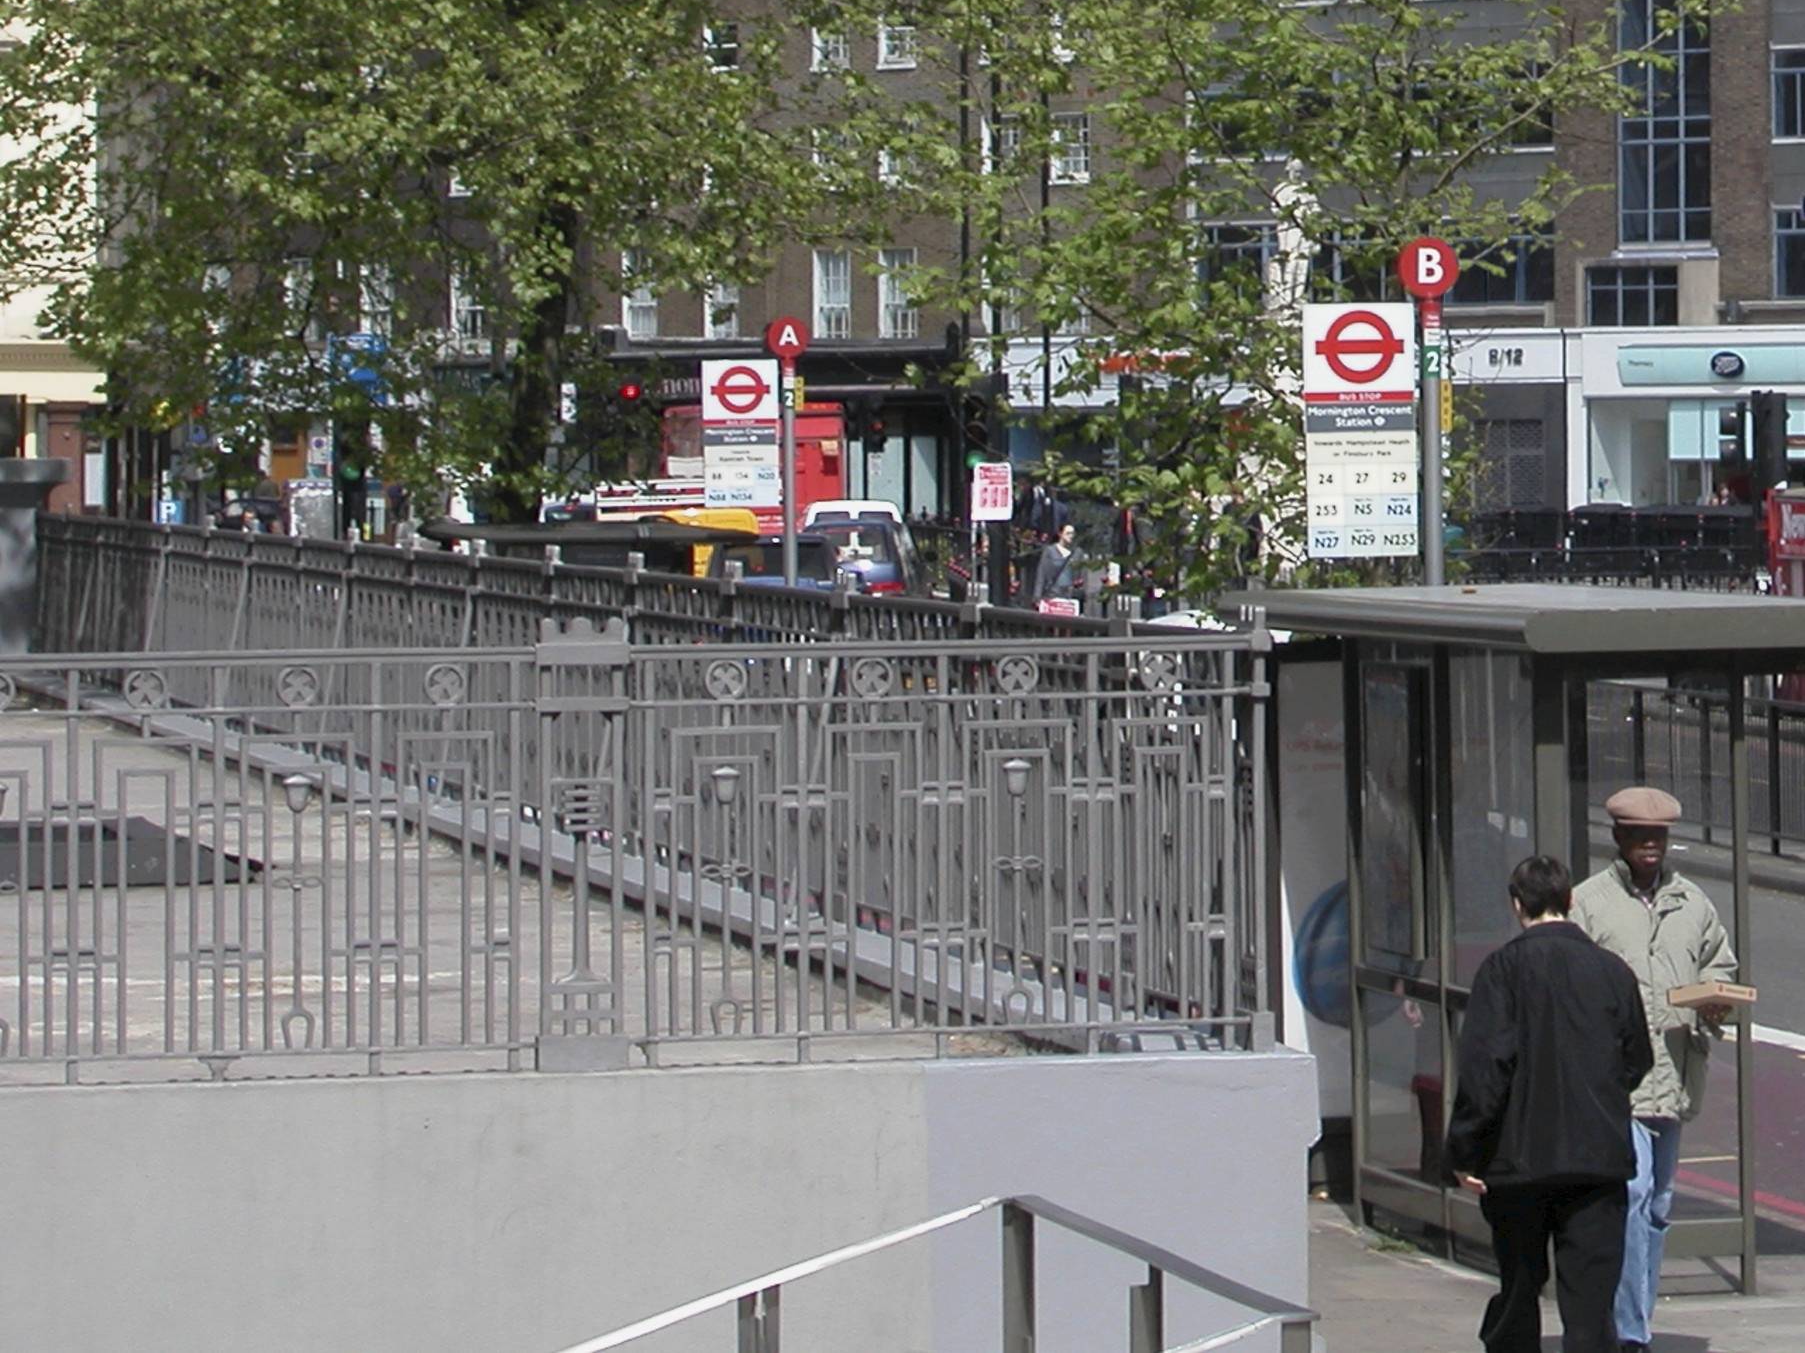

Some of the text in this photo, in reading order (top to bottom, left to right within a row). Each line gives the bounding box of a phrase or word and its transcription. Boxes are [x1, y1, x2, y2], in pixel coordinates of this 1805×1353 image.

[1418, 248, 1444, 284] B
[779, 325, 799, 346] A
[1426, 351, 1439, 373] 2
[785, 393, 793, 406] 2
[1308, 406, 1412, 418] Mornington Crescent
[1336, 417, 1372, 427] Station
[1319, 474, 1333, 484] 24
[1356, 473, 1369, 484] 27
[1392, 472, 1407, 483] 29
[1316, 505, 1338, 516] 253
[1354, 504, 1372, 515] N5
[1387, 505, 1411, 516] N24
[1315, 537, 1339, 549] N27
[1351, 535, 1376, 546] N29
[1384, 534, 1415, 546] N253
